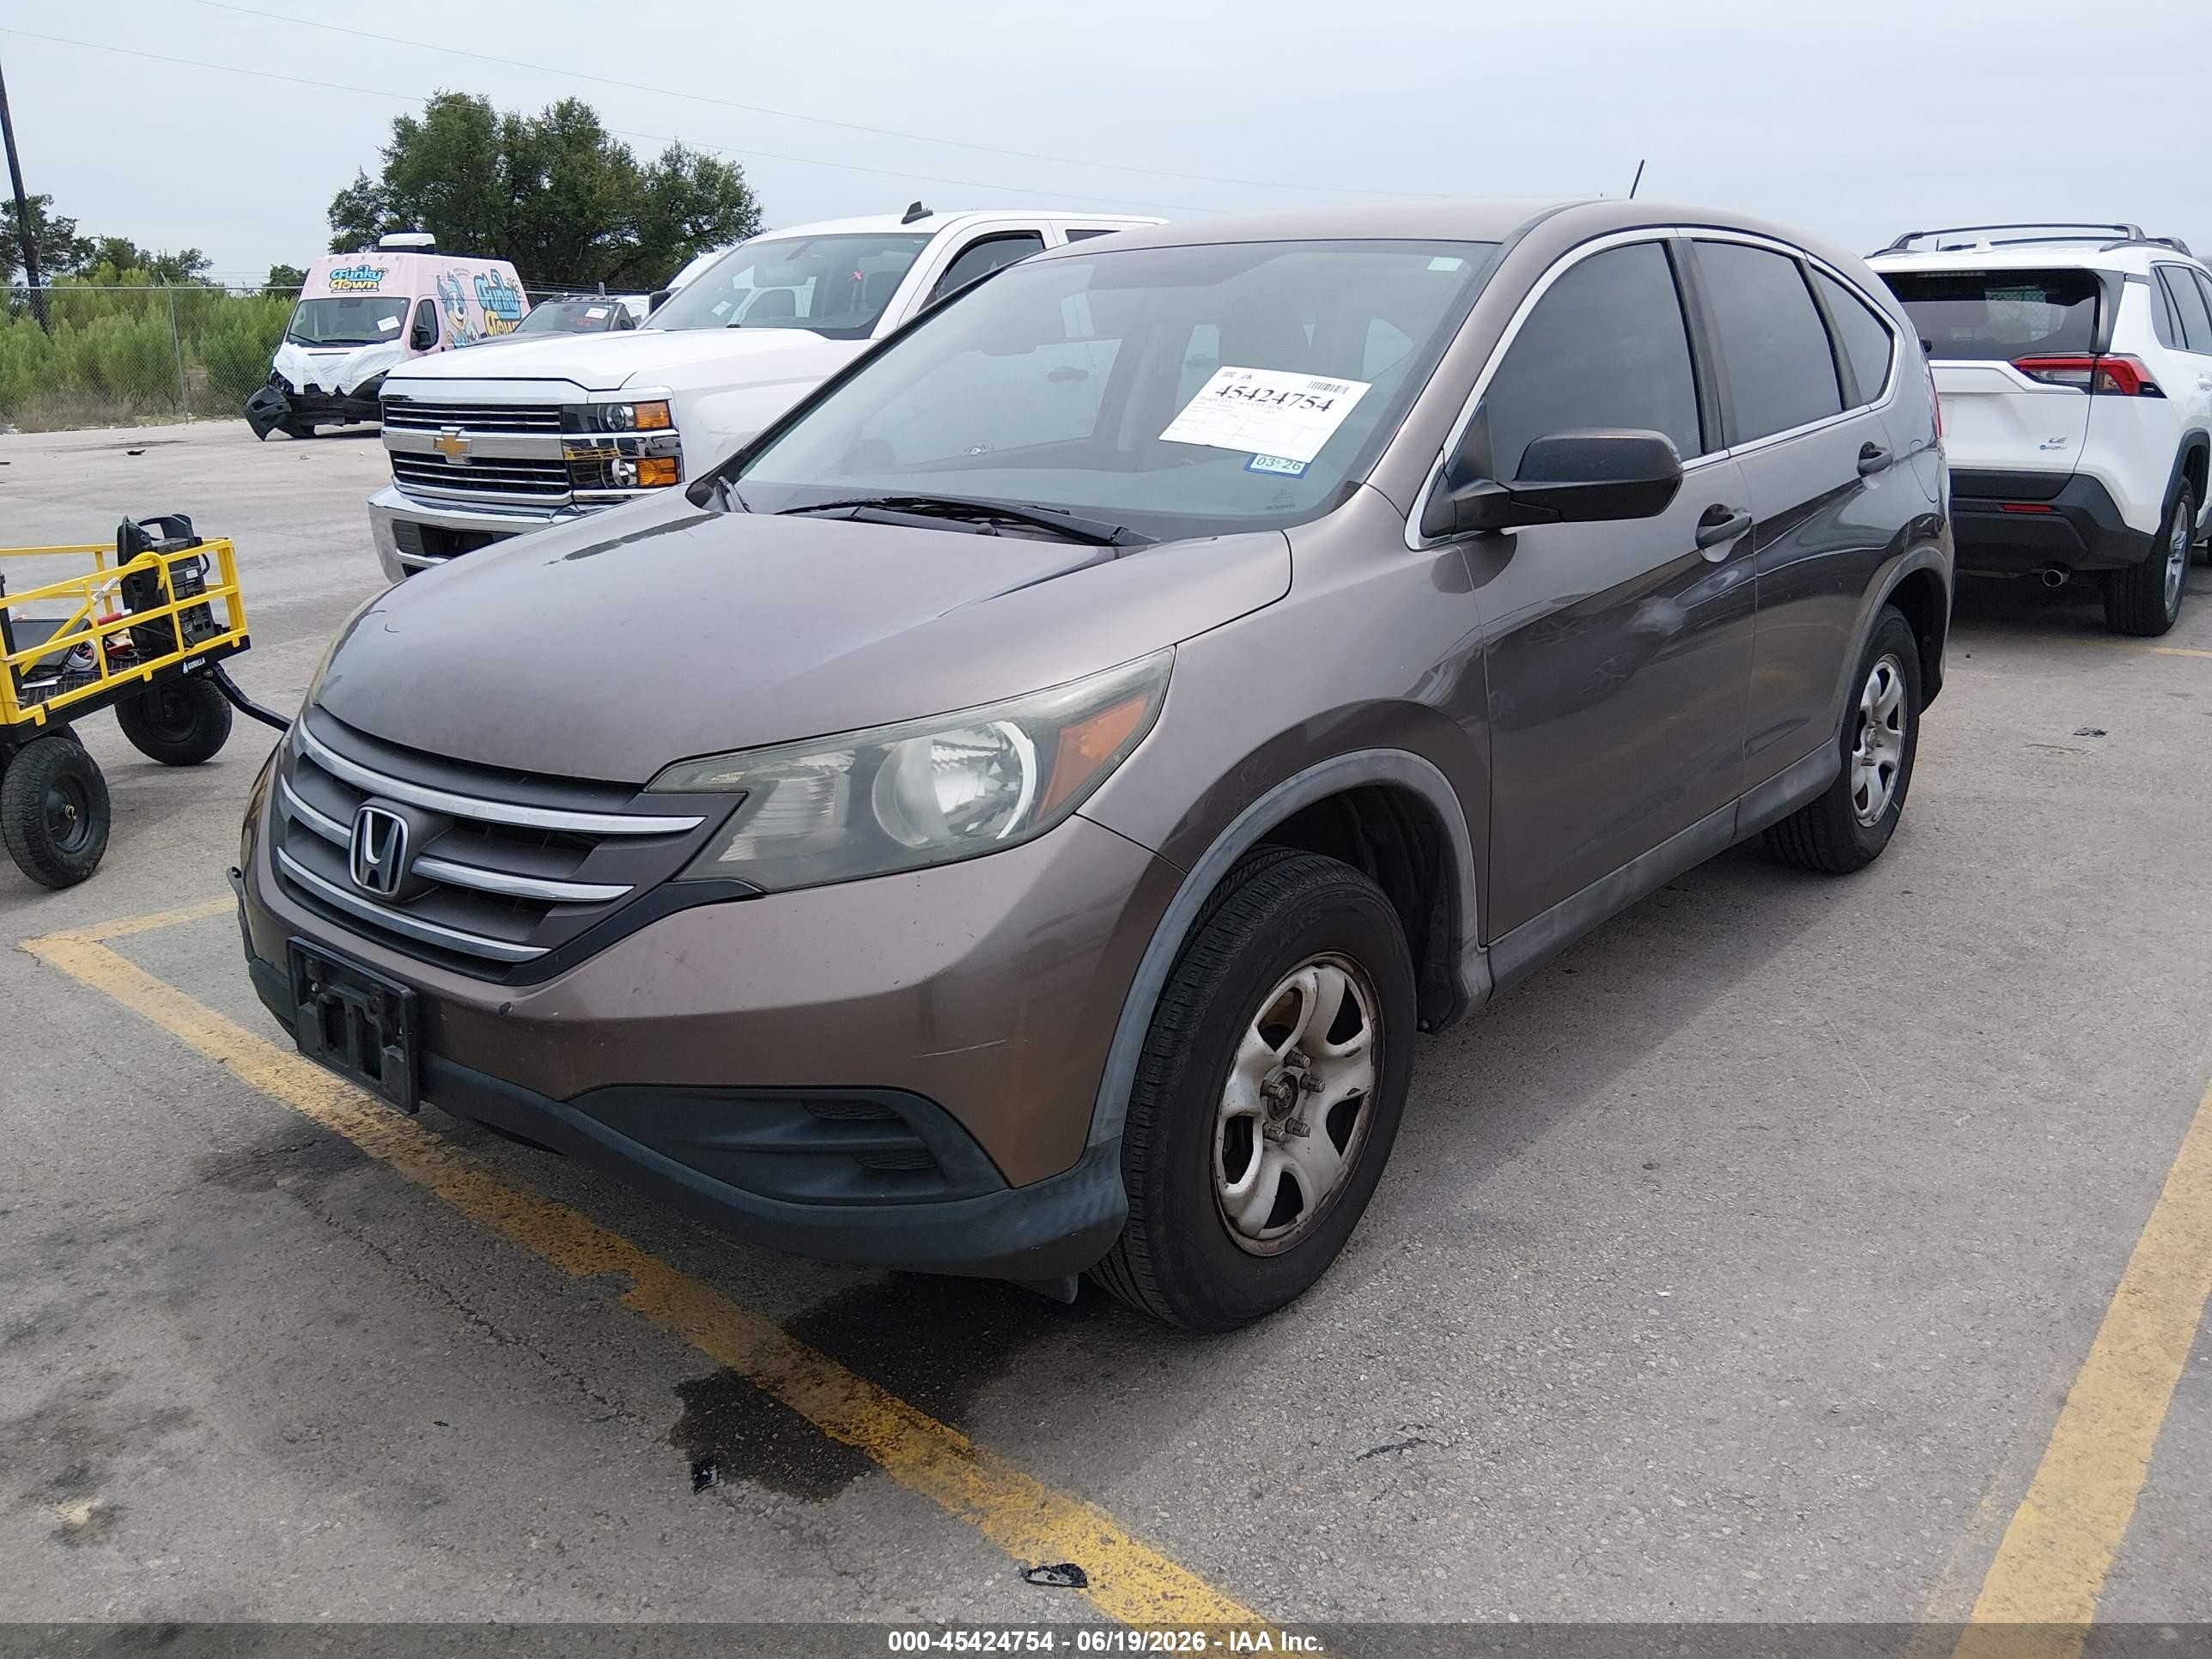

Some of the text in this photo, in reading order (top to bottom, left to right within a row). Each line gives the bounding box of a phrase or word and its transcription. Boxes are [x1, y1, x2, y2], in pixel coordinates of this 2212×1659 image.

[330, 264, 383, 282] Funky
[329, 279, 379, 289] Town
[474, 268, 522, 321] Funky
[1215, 385, 1334, 412] 45424754
[1256, 457, 1302, 471] 03 26
